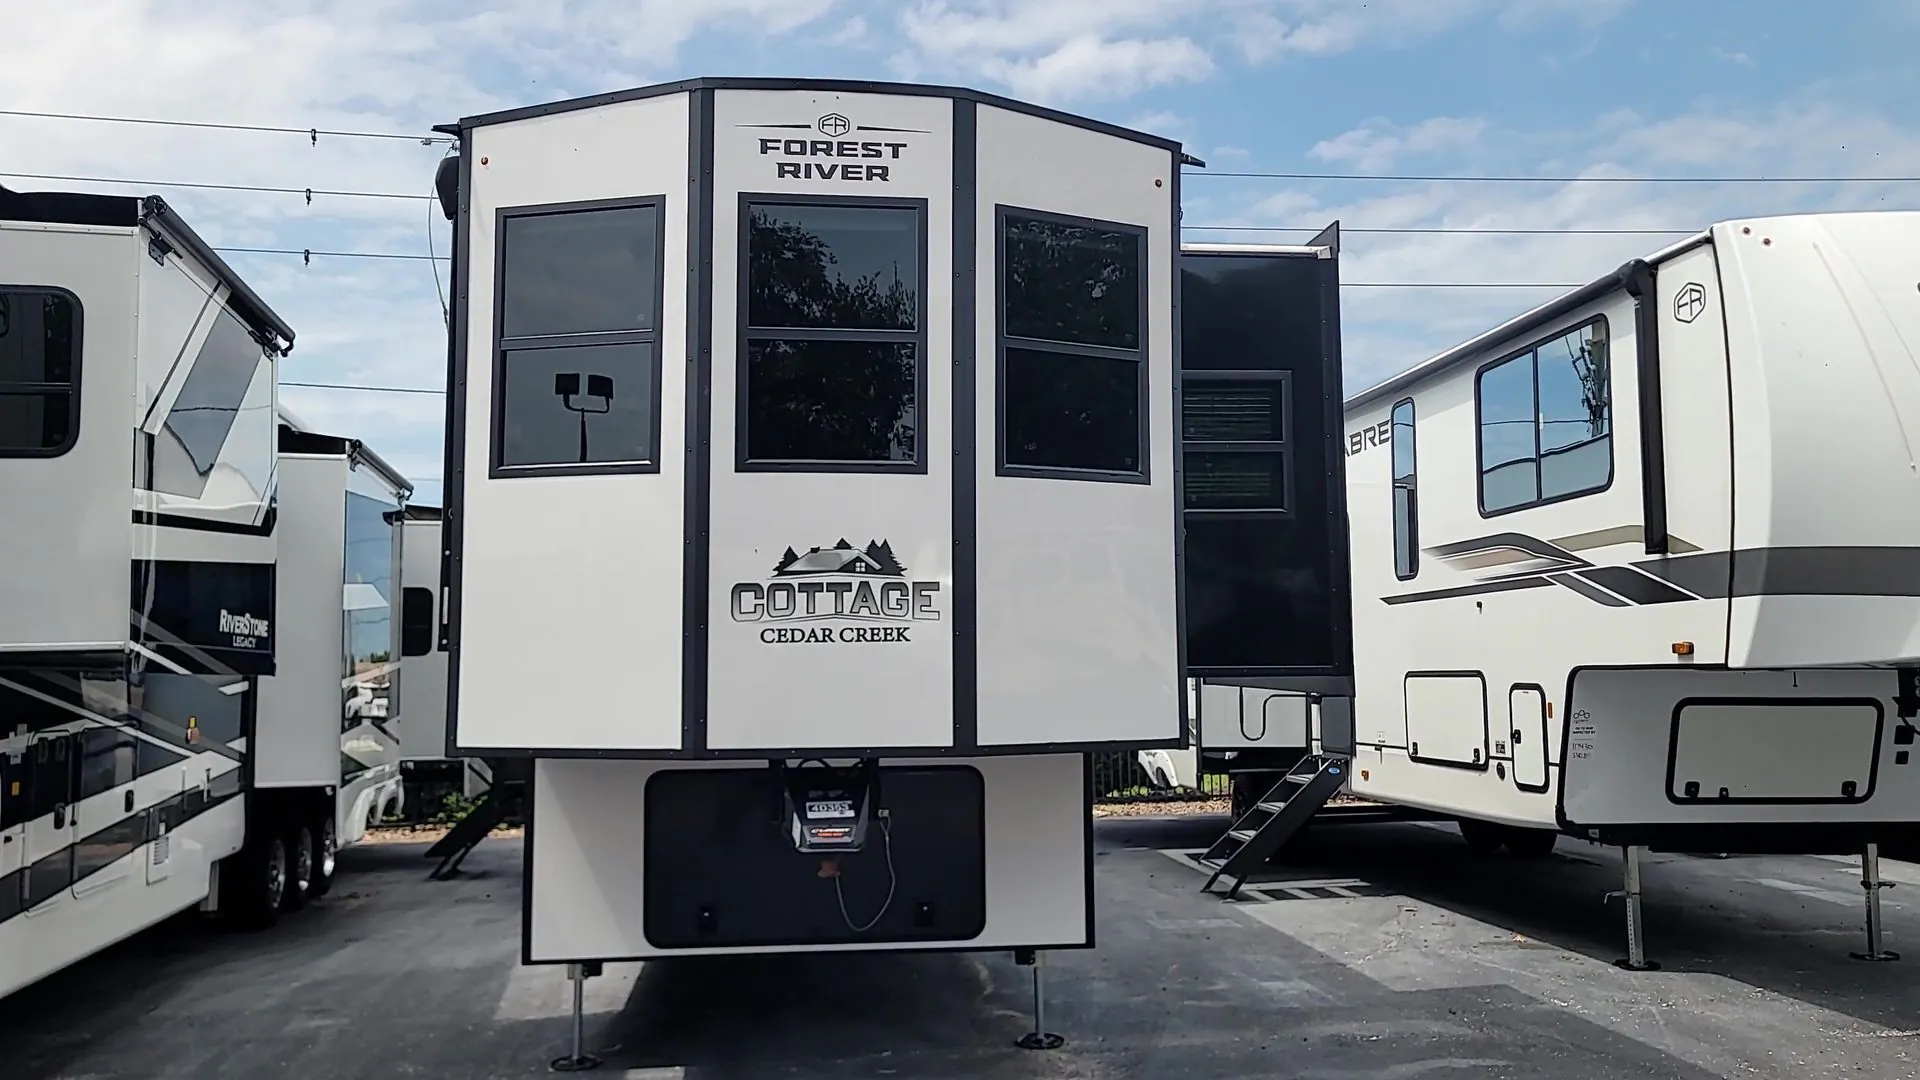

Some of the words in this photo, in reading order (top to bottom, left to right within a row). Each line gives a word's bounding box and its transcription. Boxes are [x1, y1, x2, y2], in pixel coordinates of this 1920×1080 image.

[758, 138, 907, 159] FOREST
[776, 162, 889, 181] RIVER
[731, 581, 940, 622] COTTAGE
[232, 635, 257, 648] LEGACY
[760, 627, 835, 643] CEDAR
[839, 627, 911, 642] CREEK
